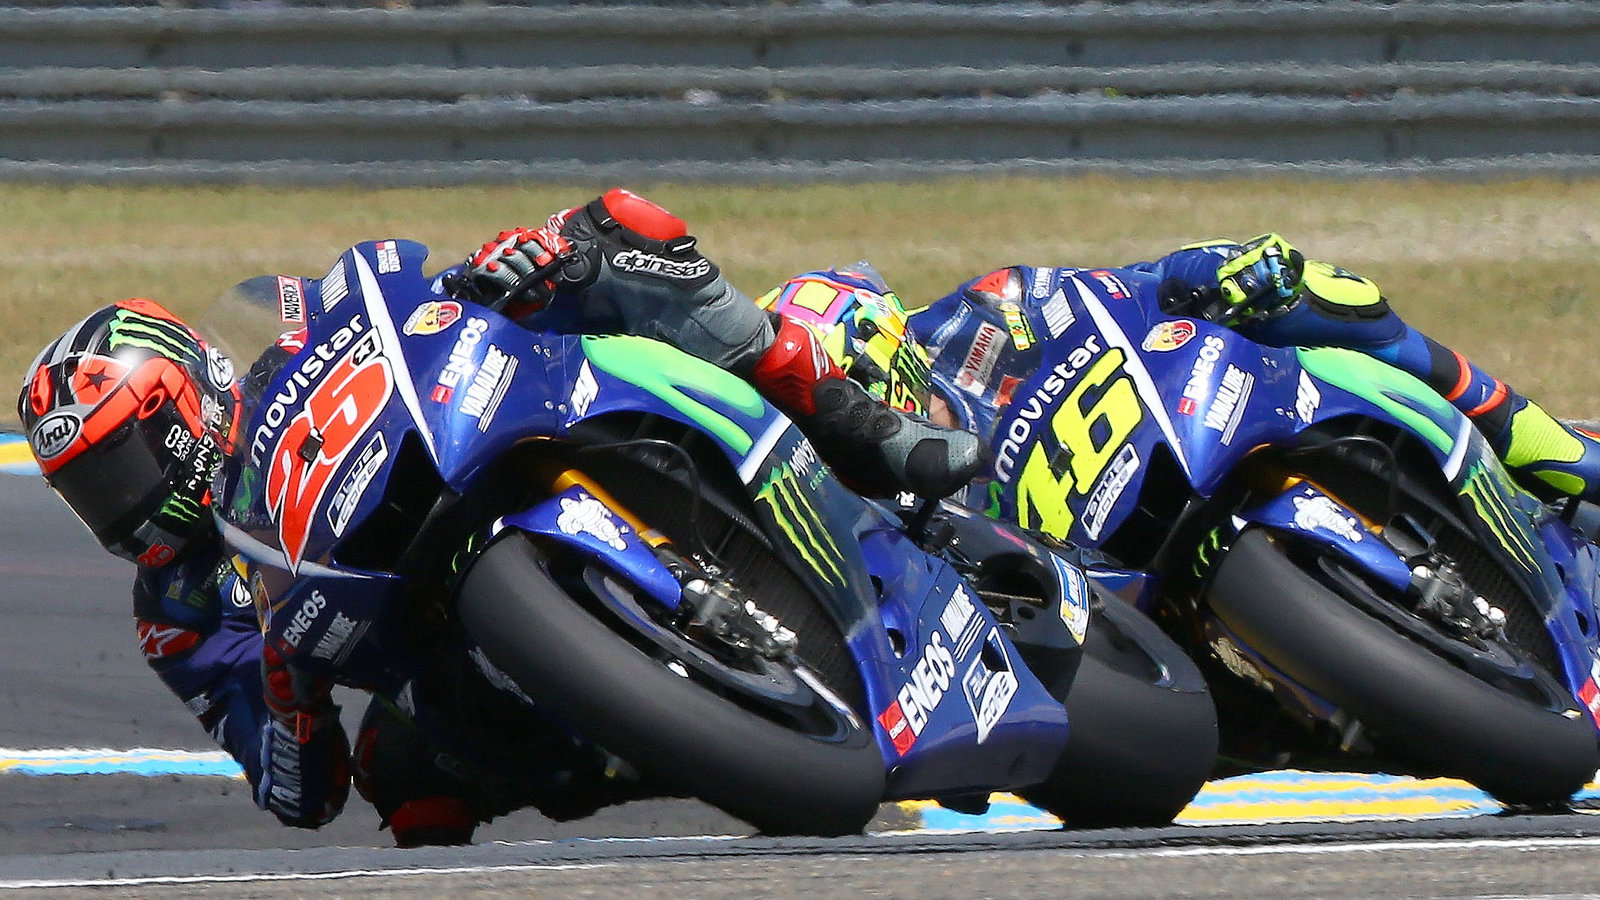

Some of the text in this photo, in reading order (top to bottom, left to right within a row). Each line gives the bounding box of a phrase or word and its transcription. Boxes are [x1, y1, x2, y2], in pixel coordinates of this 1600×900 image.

[437, 317, 489, 388] ENEOS
[459, 344, 509, 418] YAMALUBE
[966, 326, 996, 372] YAMAHA
[1182, 335, 1225, 401] ENEOS
[251, 314, 364, 468] movistar
[994, 334, 1102, 483] movistar
[1202, 363, 1247, 432] YAMALUBE
[38, 416, 71, 454] Arai
[172, 429, 191, 458] LANG
[1016, 347, 1143, 540] 46
[282, 589, 327, 648] ENEOS
[897, 630, 956, 738] ENEOS
